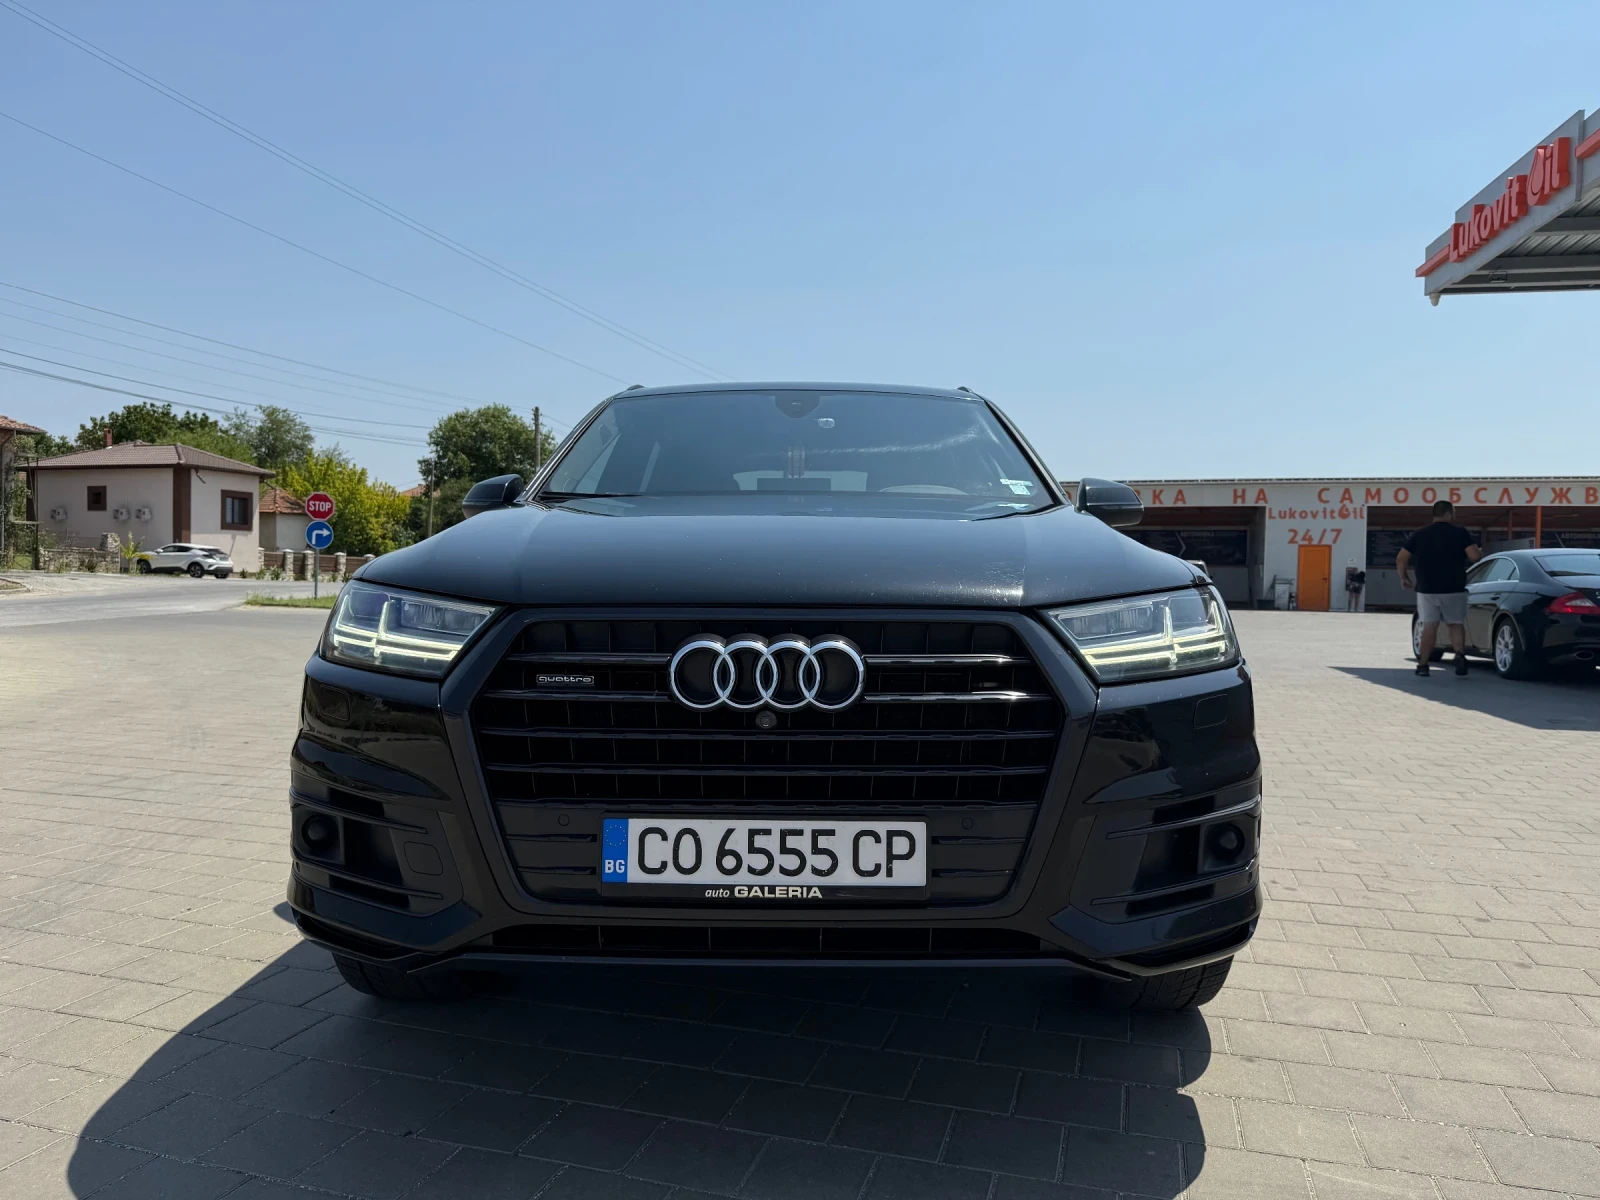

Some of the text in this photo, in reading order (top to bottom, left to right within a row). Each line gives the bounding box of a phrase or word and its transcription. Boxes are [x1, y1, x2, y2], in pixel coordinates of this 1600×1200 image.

[1233, 488, 1268, 504] НА
[309, 501, 331, 512] STOP
[1287, 529, 1342, 544] 24/7
[637, 827, 916, 877] CO 6555 CP
[604, 860, 625, 874] BG
[705, 886, 823, 898] auto GALERIA
